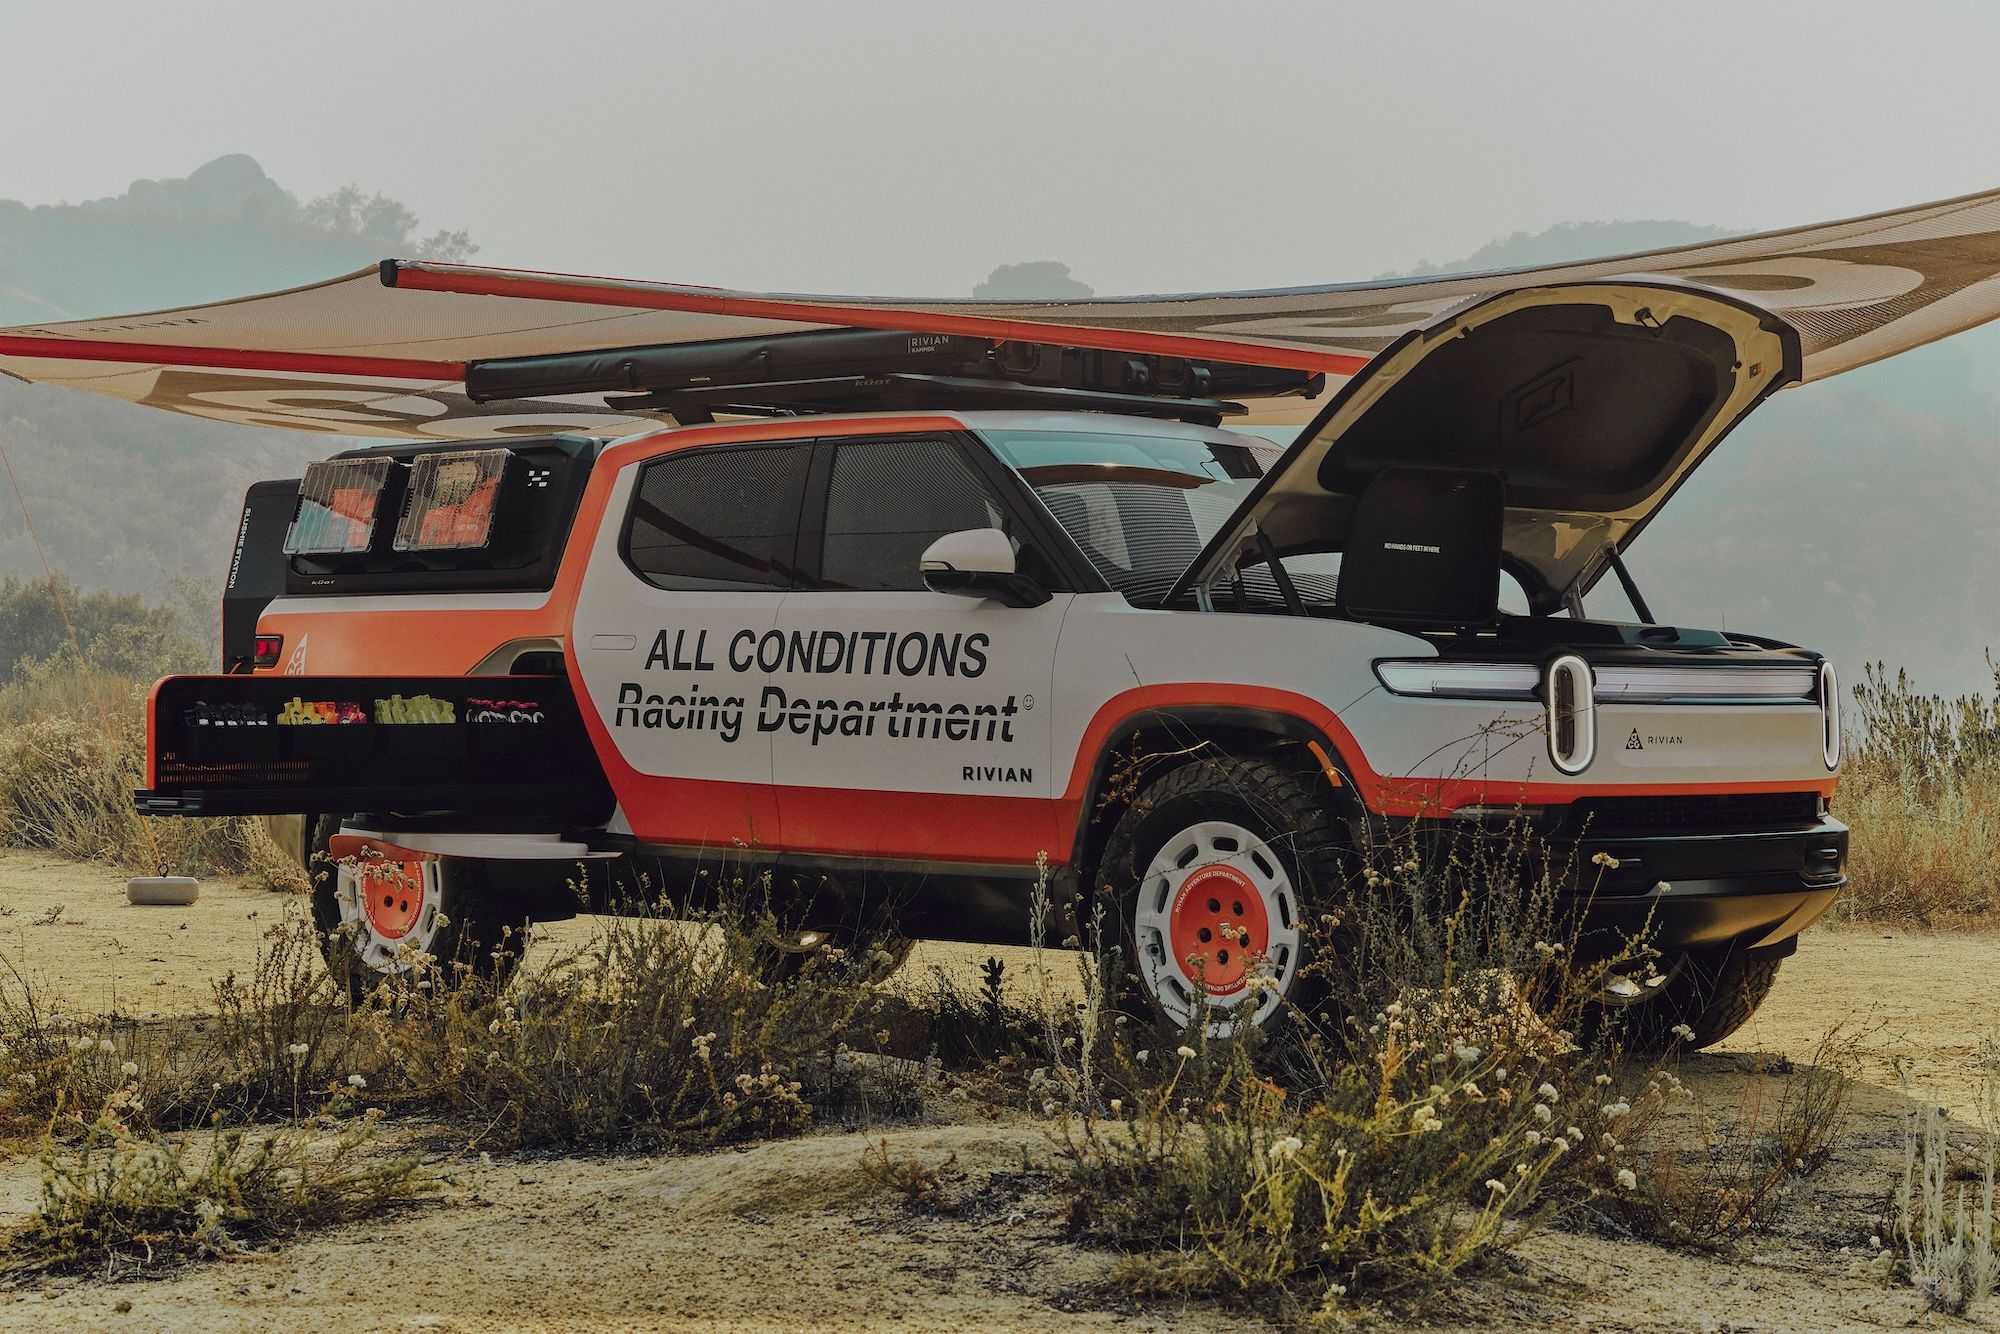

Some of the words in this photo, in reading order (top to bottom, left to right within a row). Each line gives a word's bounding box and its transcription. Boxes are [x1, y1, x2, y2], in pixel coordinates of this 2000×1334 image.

[911, 336, 949, 346] RIVIAN
[238, 508, 251, 547] SLUSHIE
[1391, 543, 1406, 551] HANDS
[228, 548, 243, 589] STATION
[644, 629, 715, 671] ALL
[728, 629, 990, 679] CONDITIONS
[615, 682, 745, 743] Racing
[757, 685, 1018, 746] Department
[1647, 736, 1683, 744] RIVIAN
[962, 766, 1032, 783] RIVIAN
[1175, 891, 1187, 914] RIVIAN
[1184, 870, 1212, 893] ADVENTURE
[1212, 870, 1246, 888] DEPARTMENT
